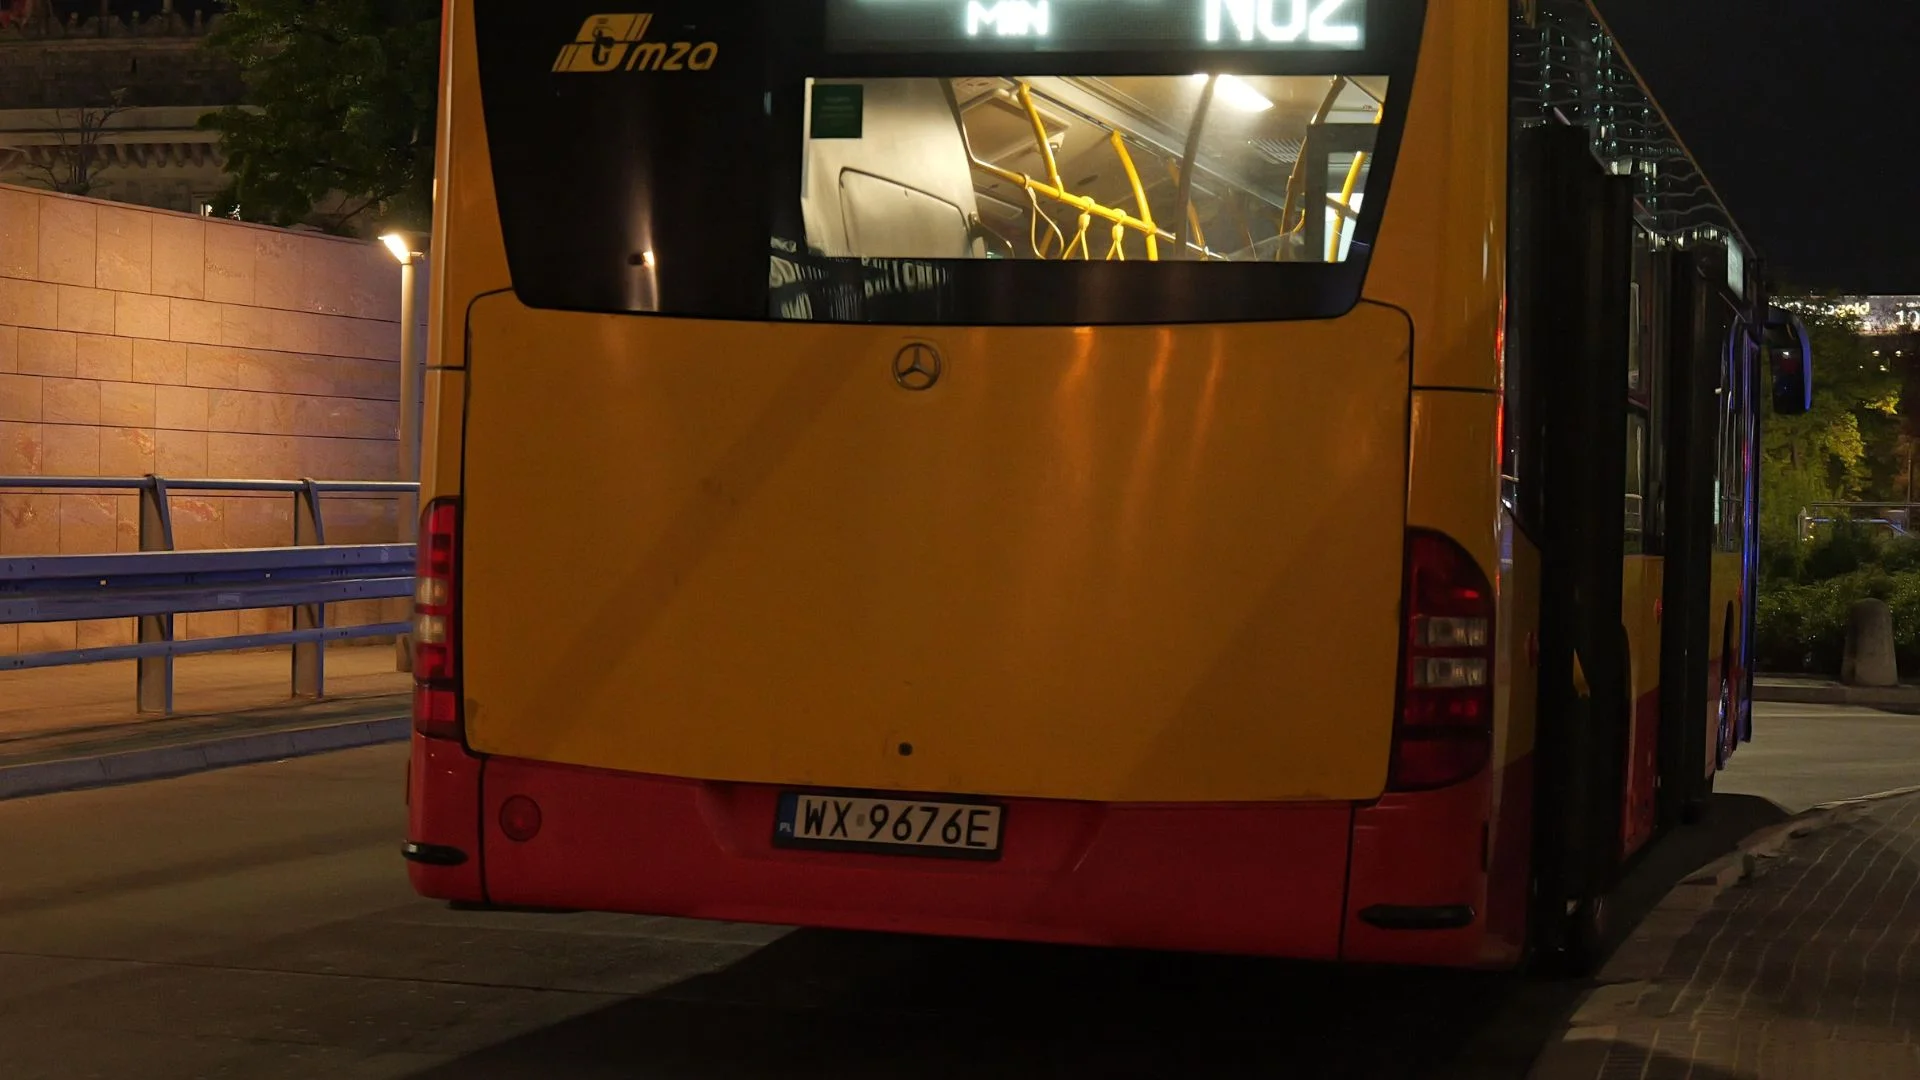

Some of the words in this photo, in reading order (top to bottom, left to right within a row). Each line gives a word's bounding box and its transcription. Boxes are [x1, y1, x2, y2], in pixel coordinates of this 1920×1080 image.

[624, 41, 719, 72] mza
[779, 822, 791, 833] PL
[804, 800, 853, 838] WX
[868, 804, 992, 847] 9676E
